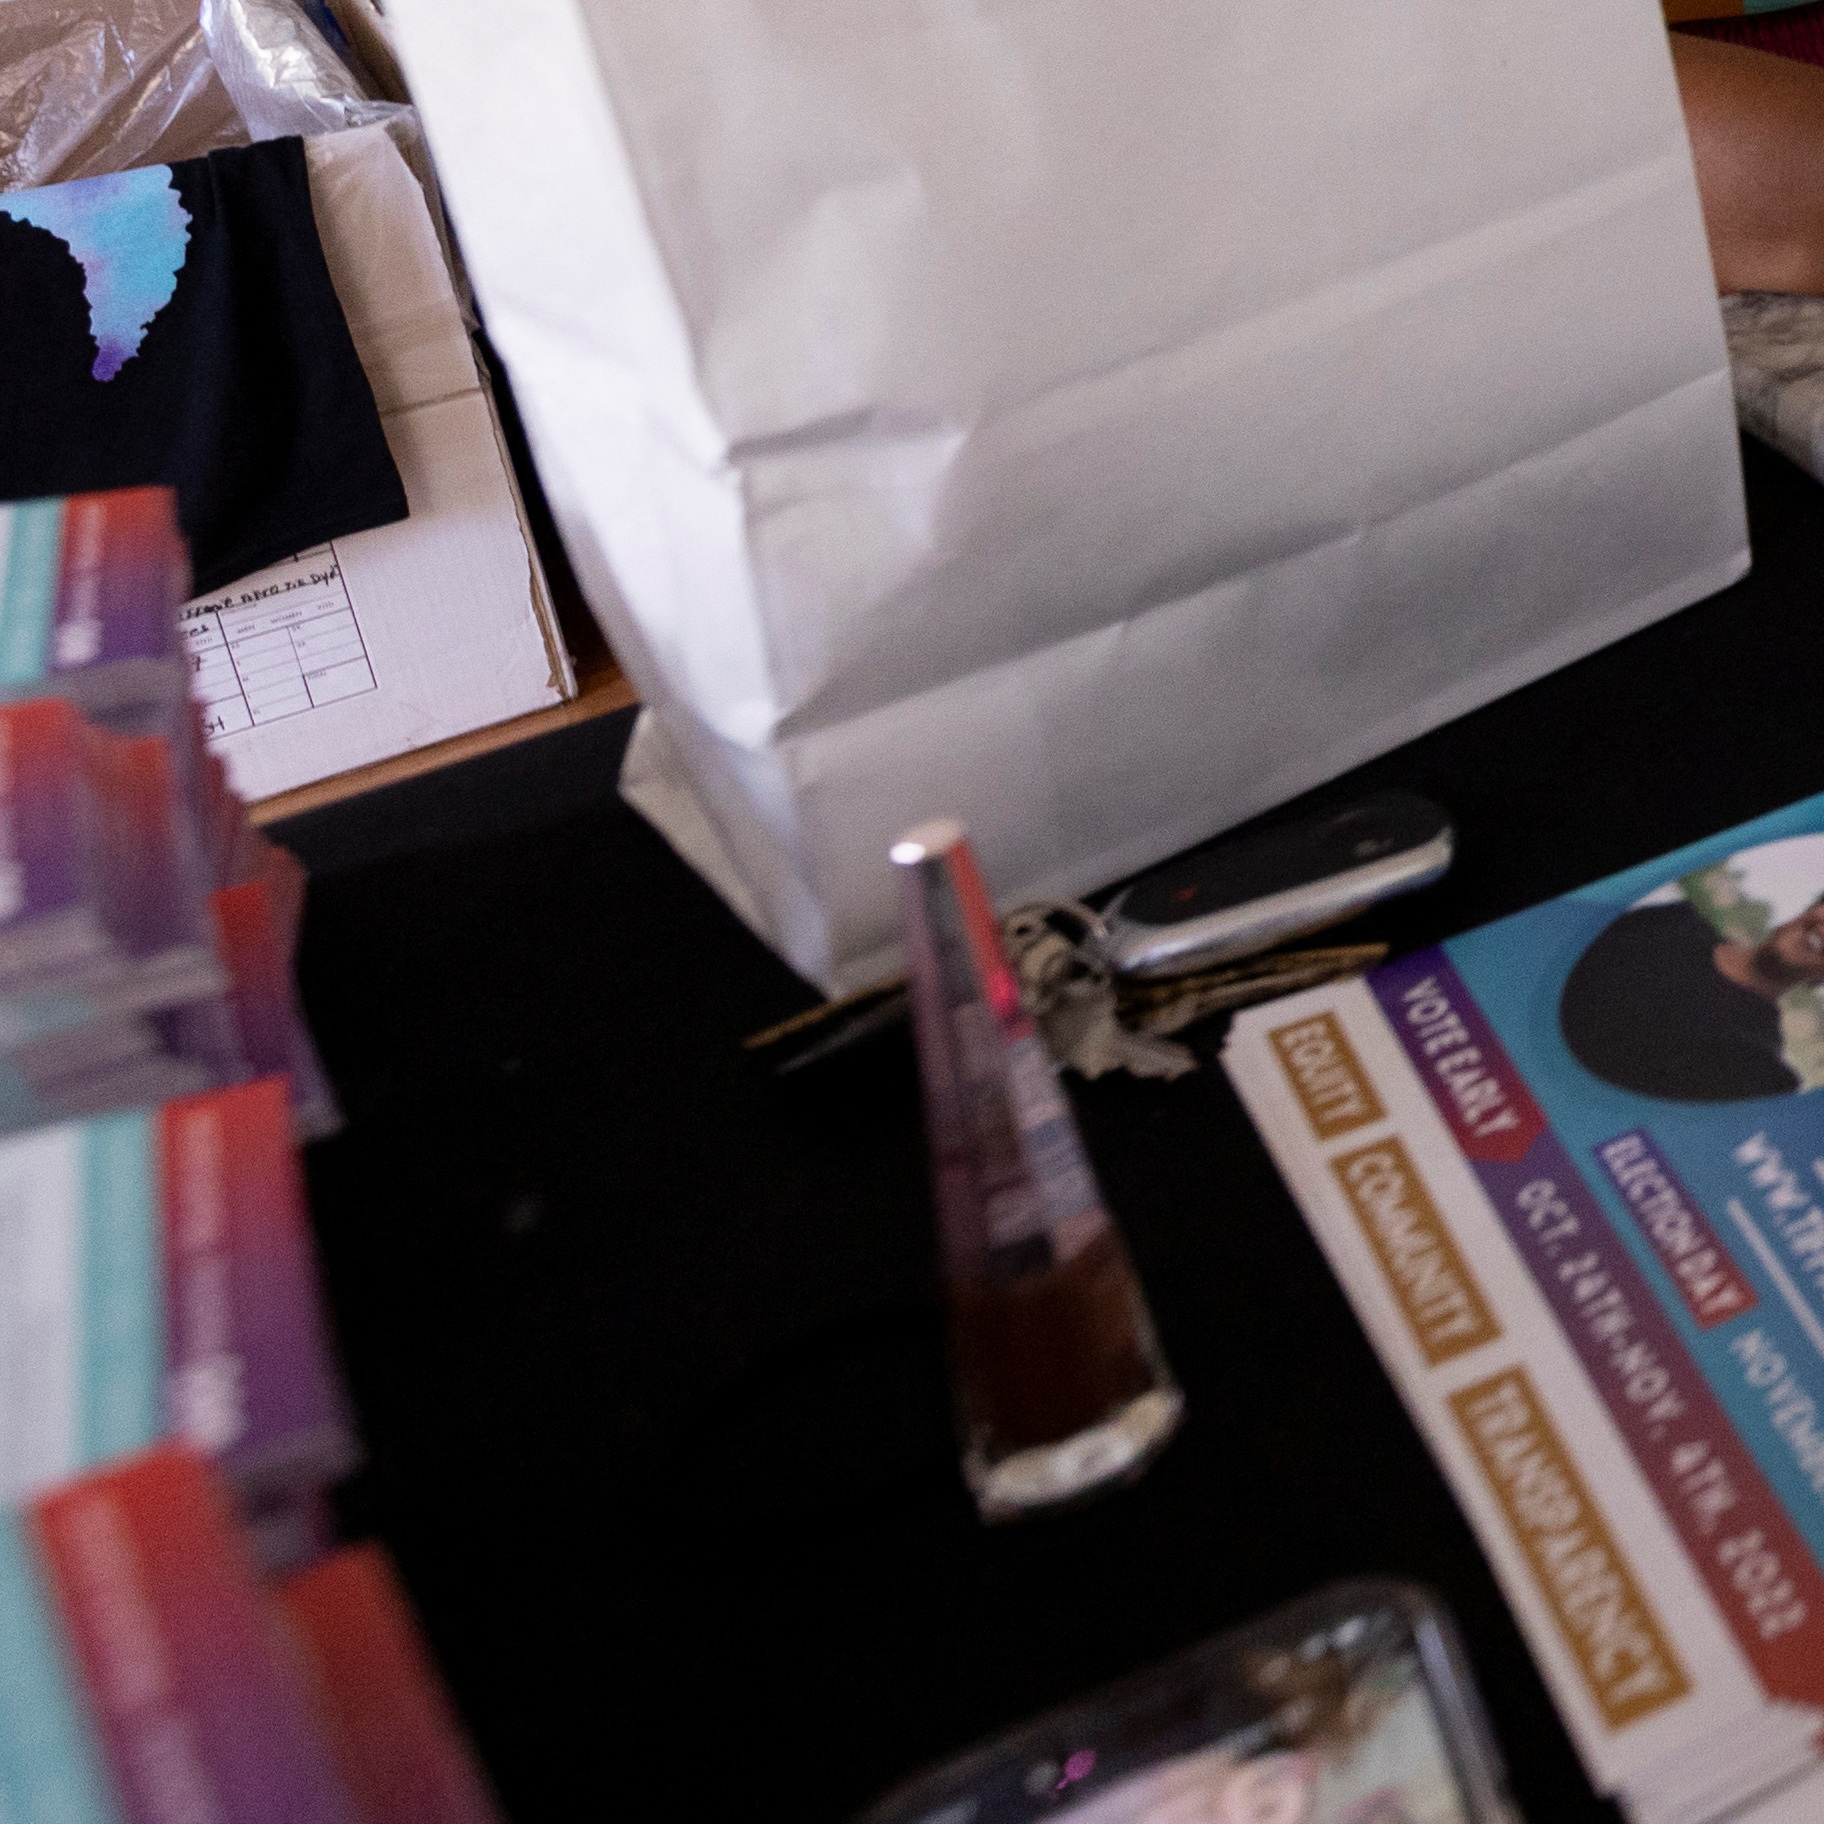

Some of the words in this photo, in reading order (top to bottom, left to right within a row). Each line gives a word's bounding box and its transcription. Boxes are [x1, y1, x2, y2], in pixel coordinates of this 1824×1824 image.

[1281, 1019, 1367, 1127] EQUITY
[1345, 1148, 1482, 1349] COMMUNITY
[1397, 972, 1474, 1051] VOTE
[1440, 1036, 1522, 1141] EARLY
[1510, 1179, 1592, 1261] OCT.
[1710, 1522, 1811, 1644] 2022
[1596, 1132, 1714, 1262] ELECTION
[1674, 1252, 1751, 1321] DAY
[1463, 1376, 1671, 1710] TRANSPARENCY
